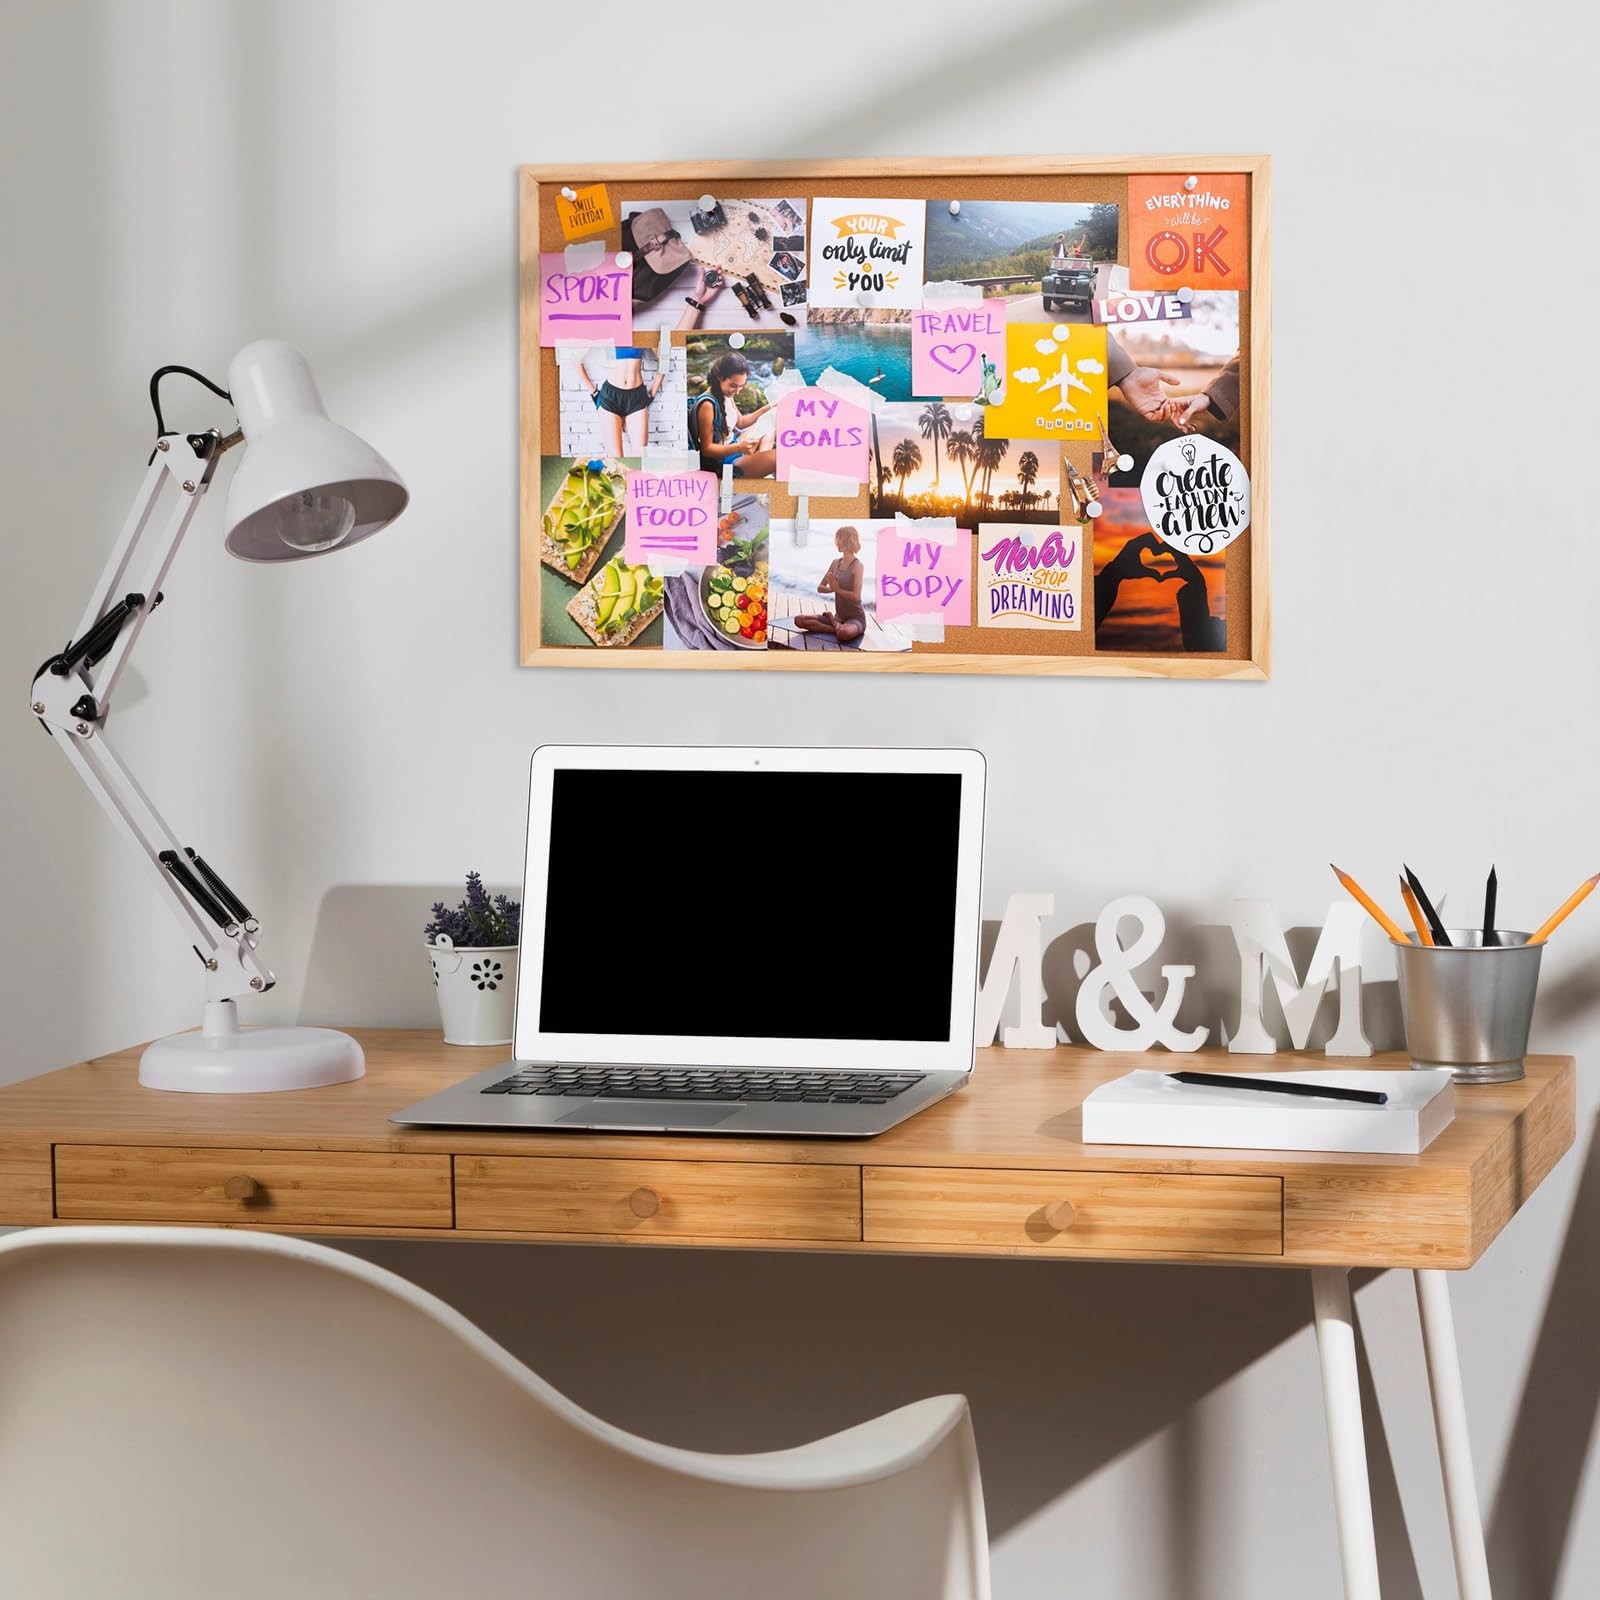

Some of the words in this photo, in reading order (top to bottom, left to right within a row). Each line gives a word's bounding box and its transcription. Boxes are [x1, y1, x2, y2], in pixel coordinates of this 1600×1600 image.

[572, 196, 595, 214] SMILE
[1145, 192, 1231, 211] EVERYTHING
[569, 208, 605, 228] EVERYDAY
[845, 217, 888, 234] YOUR
[822, 236, 867, 265] only
[869, 237, 913, 266] limit
[1145, 224, 1232, 278] OK
[545, 273, 630, 304] SPORT
[848, 272, 884, 292] YOU
[1098, 295, 1184, 323] LOVE
[914, 313, 1001, 336] TRAVEL
[795, 399, 839, 418] MY
[1036, 416, 1093, 432] SUMMER
[779, 427, 862, 448] GOALS
[1156, 453, 1234, 498] create
[631, 478, 709, 502] HEALTHY
[1164, 491, 1202, 512] EACH
[1203, 487, 1229, 505] DAY
[636, 506, 709, 527] FOOD
[902, 541, 943, 570] MY
[881, 574, 965, 607] BODY
[990, 584, 1075, 619] DREAMING
[1228, 898, 1374, 1056] M
